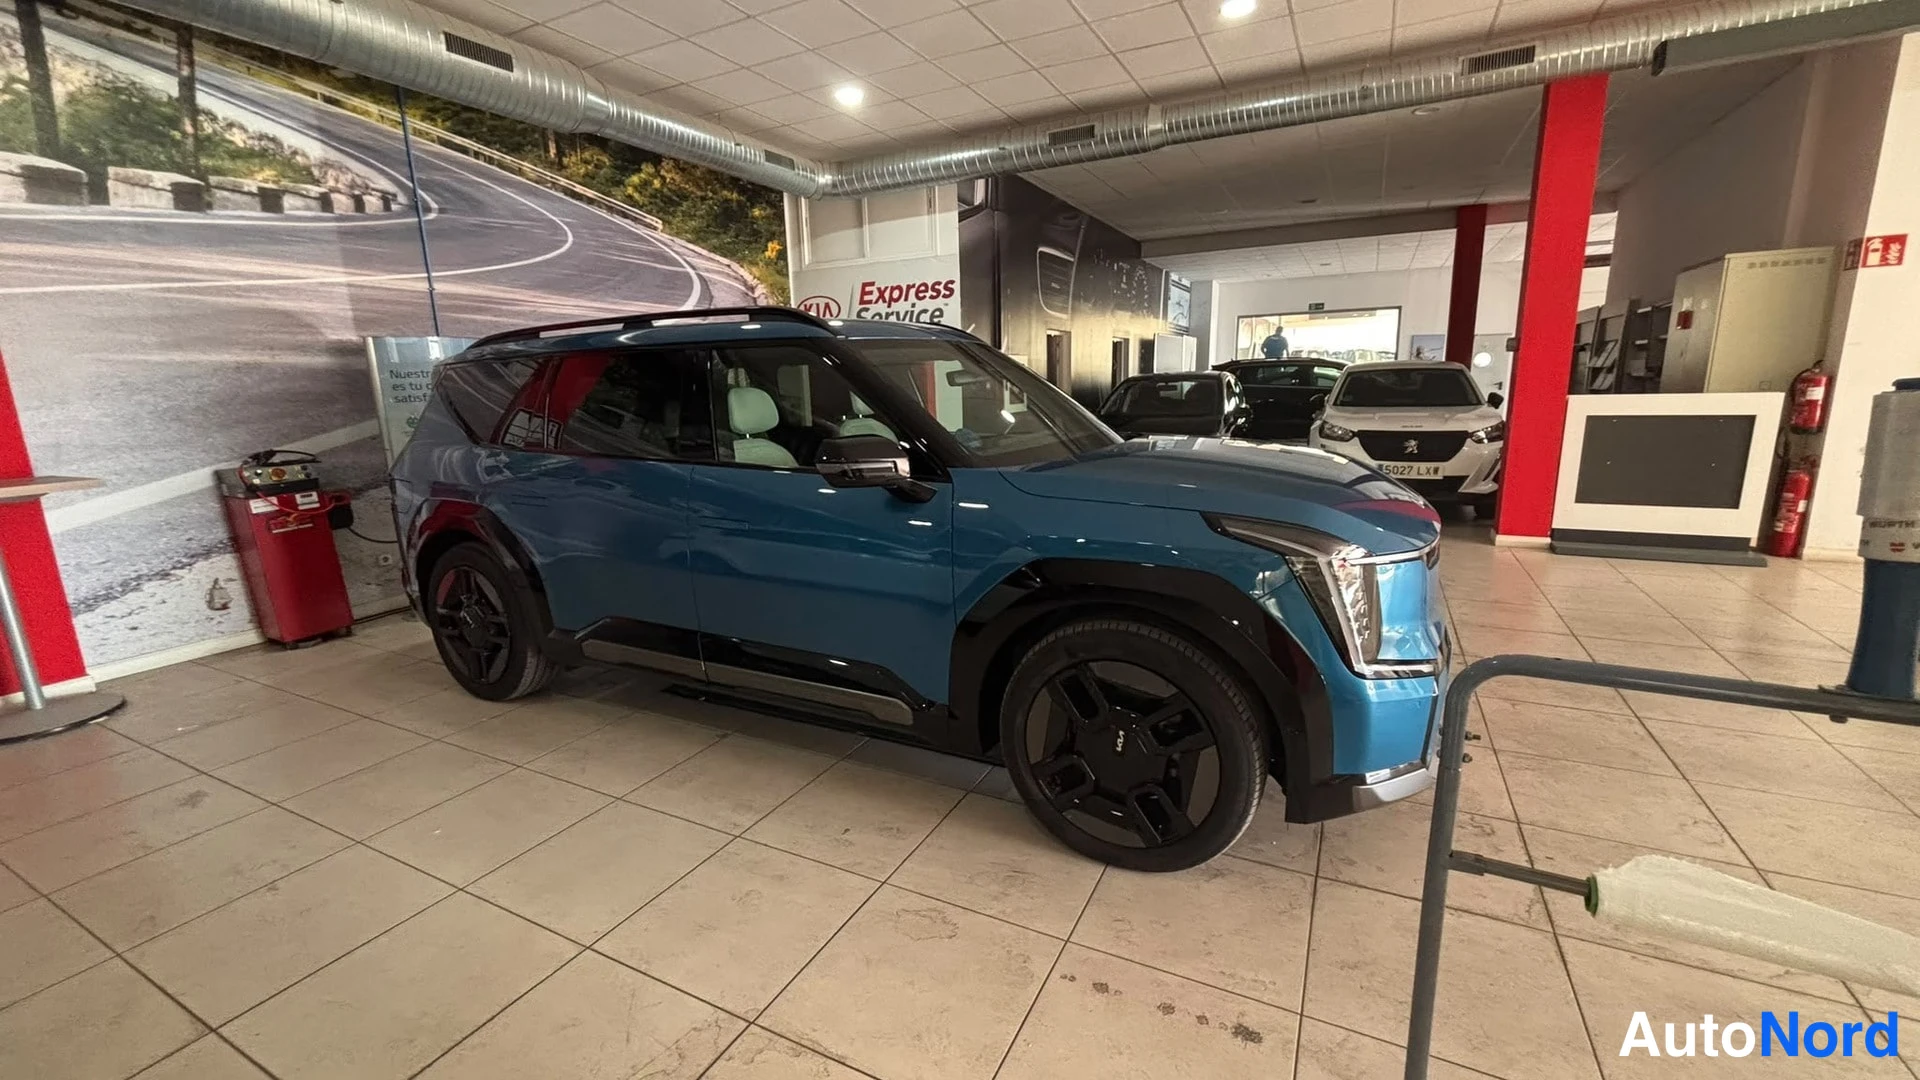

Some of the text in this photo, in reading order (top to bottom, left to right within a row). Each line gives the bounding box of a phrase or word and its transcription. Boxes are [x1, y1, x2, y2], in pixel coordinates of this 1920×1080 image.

[859, 280, 956, 308] Express
[803, 301, 834, 318] KIA
[389, 369, 430, 380] Nuestr
[392, 383, 406, 391] es
[409, 382, 423, 391] tu
[394, 393, 428, 403] satisf
[1384, 464, 1414, 476] 5027
